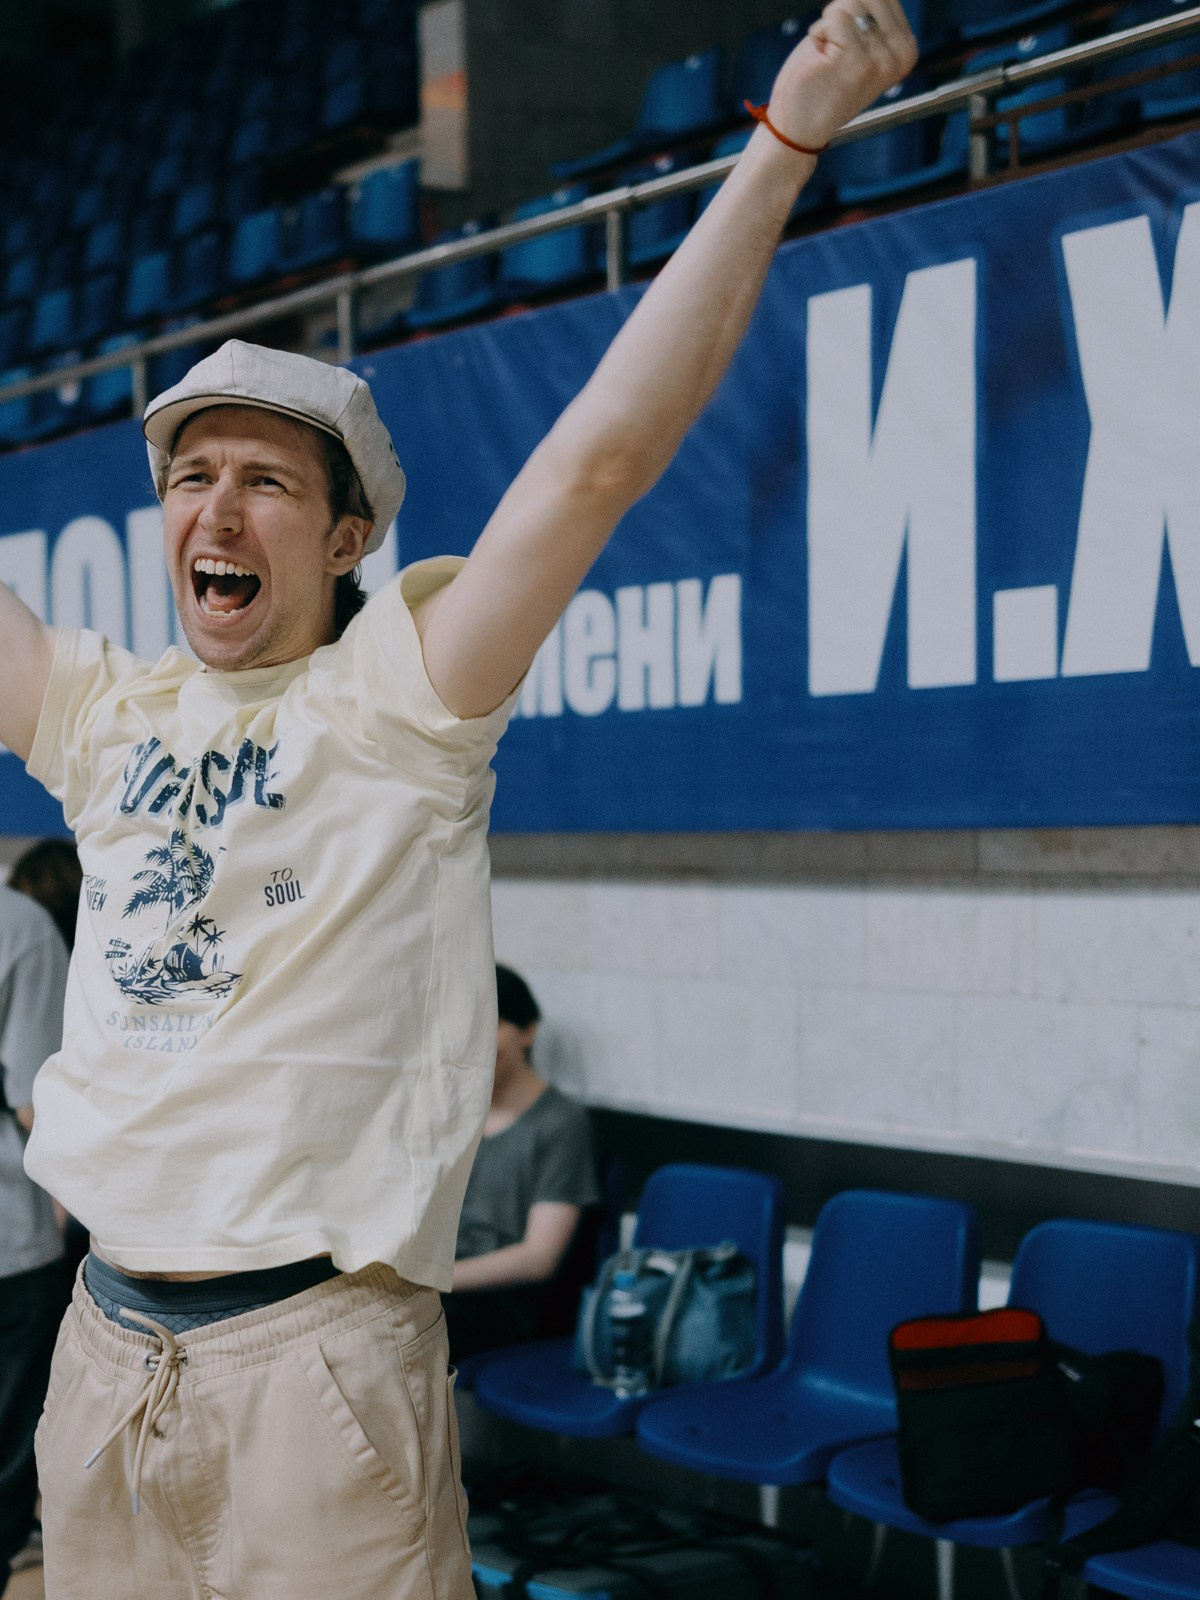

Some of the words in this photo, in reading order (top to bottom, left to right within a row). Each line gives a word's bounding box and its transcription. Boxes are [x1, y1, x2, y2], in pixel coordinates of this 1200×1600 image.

[508, 572, 743, 719] ени
[270, 867, 293, 883] TO
[264, 879, 306, 907] SOUL
